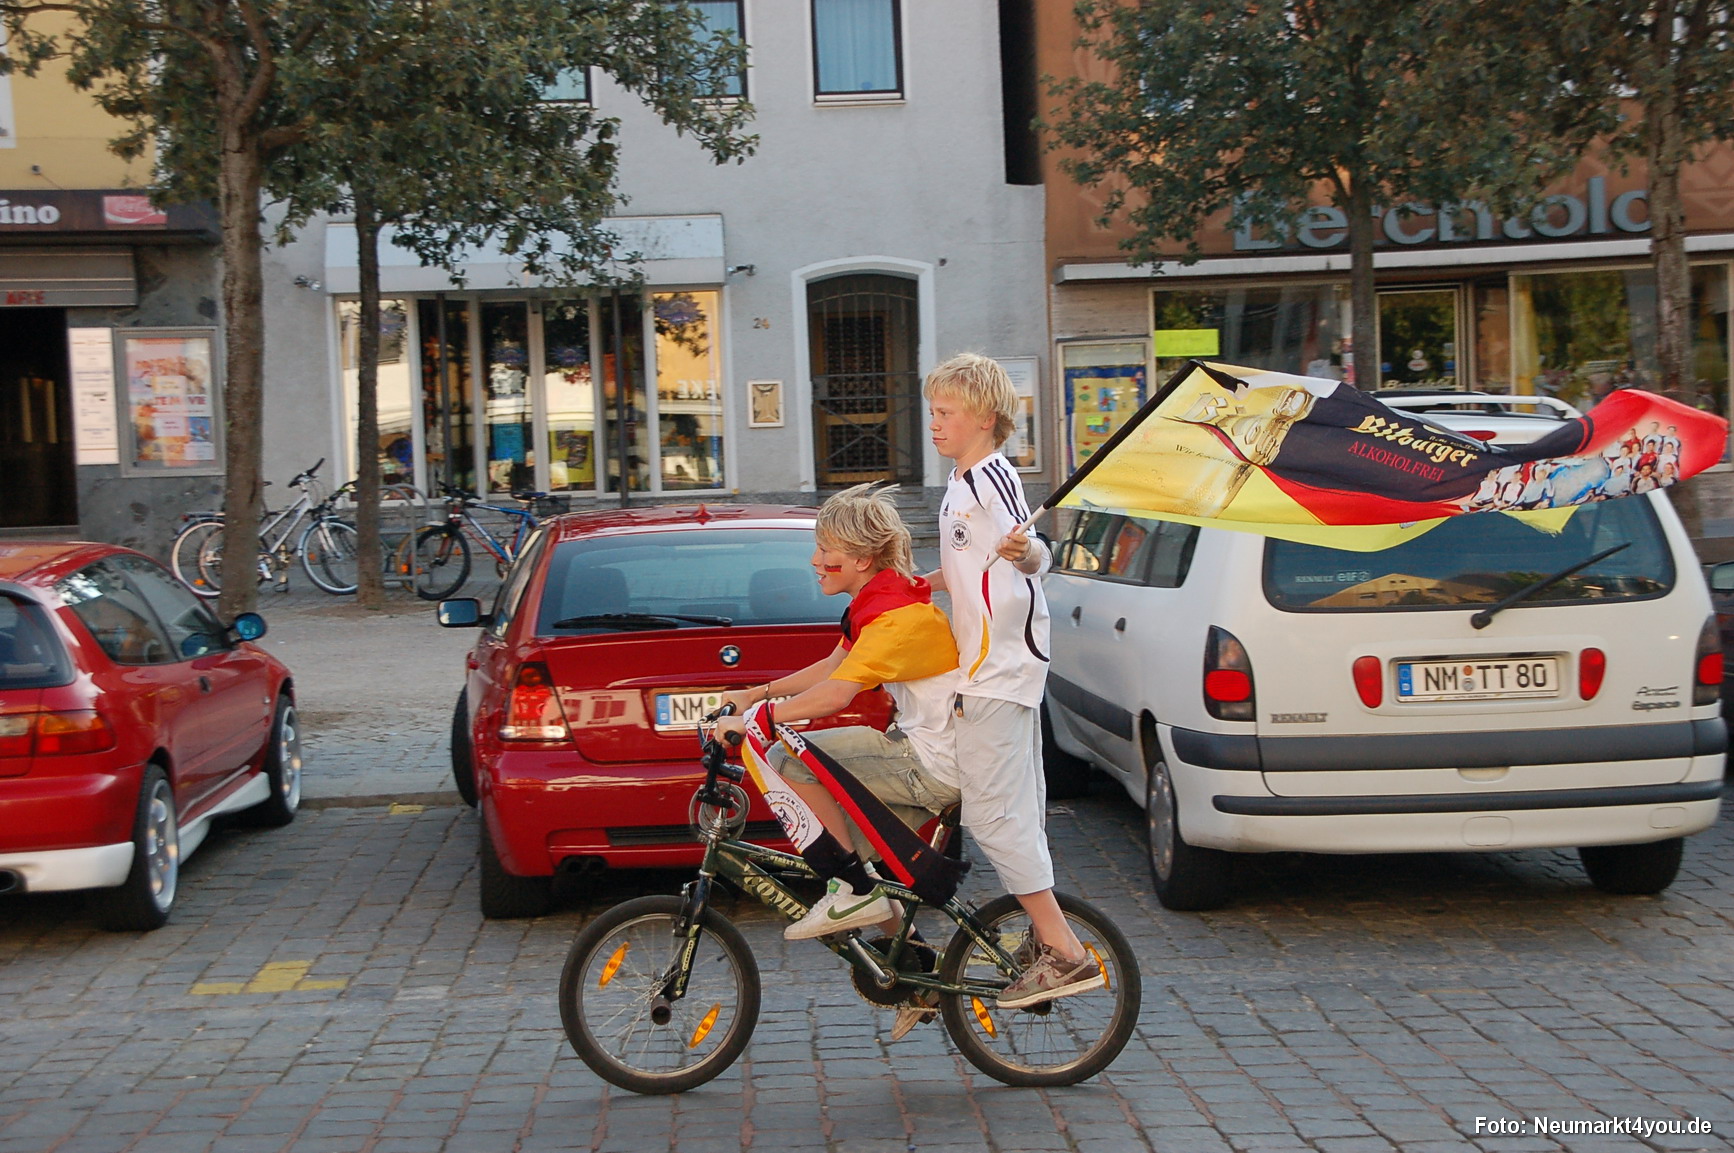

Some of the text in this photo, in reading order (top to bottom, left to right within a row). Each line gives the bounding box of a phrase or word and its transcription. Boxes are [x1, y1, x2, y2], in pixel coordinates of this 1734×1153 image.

[1348, 441, 1445, 482] ALKOHOLFREI
[1424, 663, 1547, 691] NM TT 80
[672, 697, 704, 721] NM
[1271, 712, 1328, 724] RENAULT
[744, 874, 809, 920] COMB
